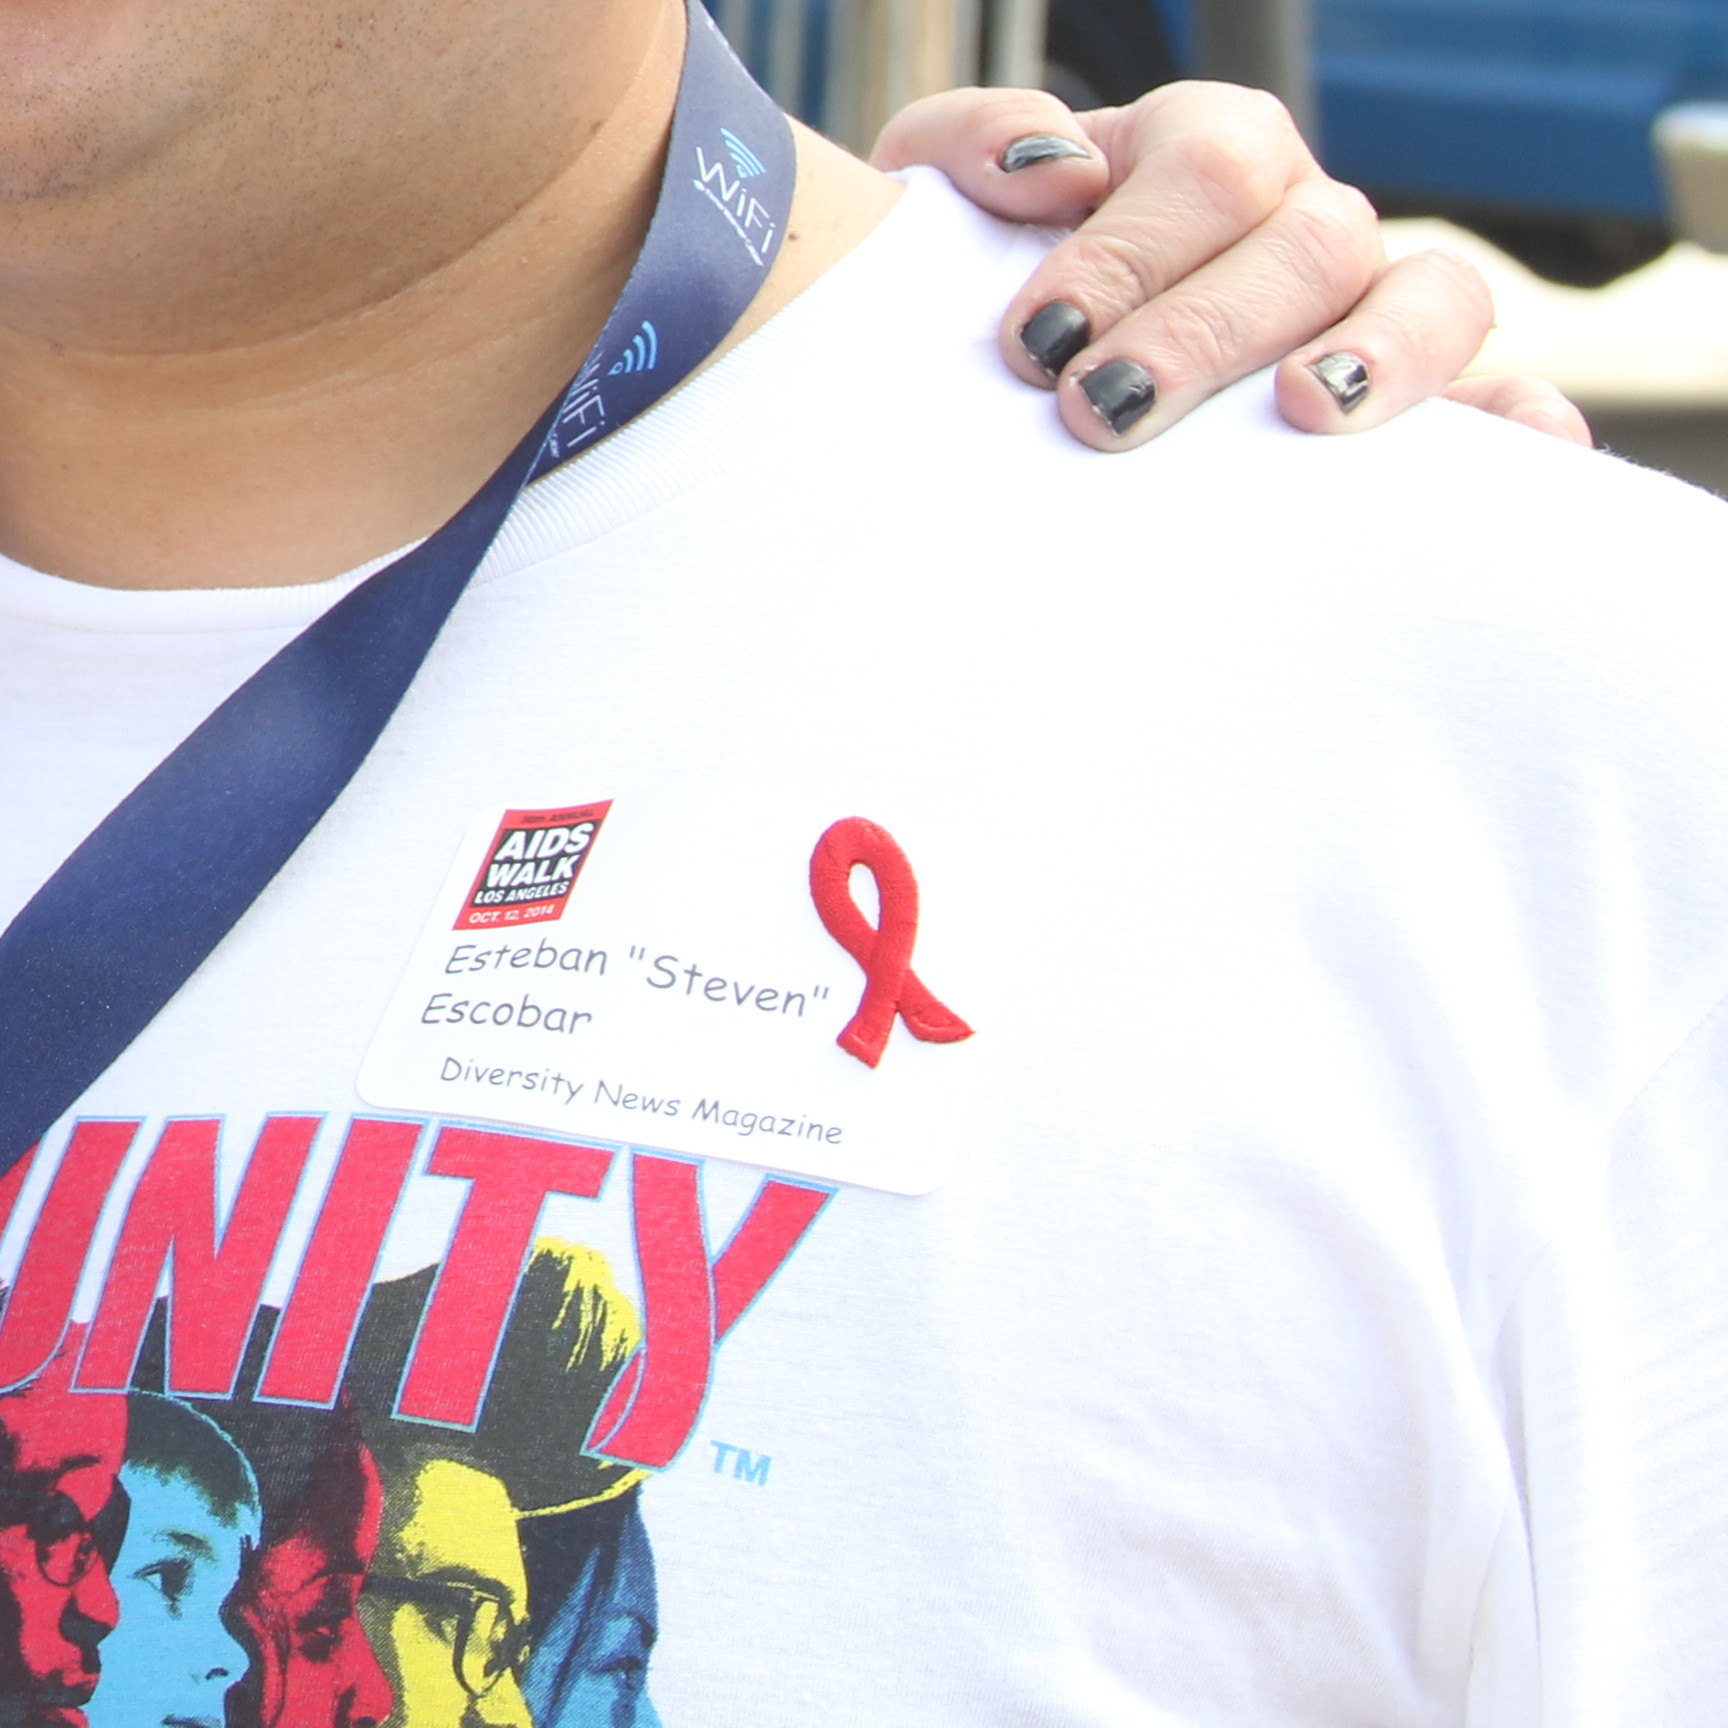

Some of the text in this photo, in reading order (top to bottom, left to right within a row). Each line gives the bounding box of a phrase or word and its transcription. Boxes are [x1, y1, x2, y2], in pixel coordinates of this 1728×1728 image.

[695, 146, 777, 254] WiFi
[493, 822, 595, 861] AIDS
[473, 880, 570, 904] LOS ANGELES
[486, 854, 582, 888] WALK
[468, 911, 501, 924] OCT.
[523, 904, 556, 919] 2014
[445, 937, 831, 1017] Esteban "Steven"
[420, 992, 593, 1035] Escobar
[439, 1057, 844, 1145] Diversity News Magazine
[709, 1439, 772, 1487] TM
